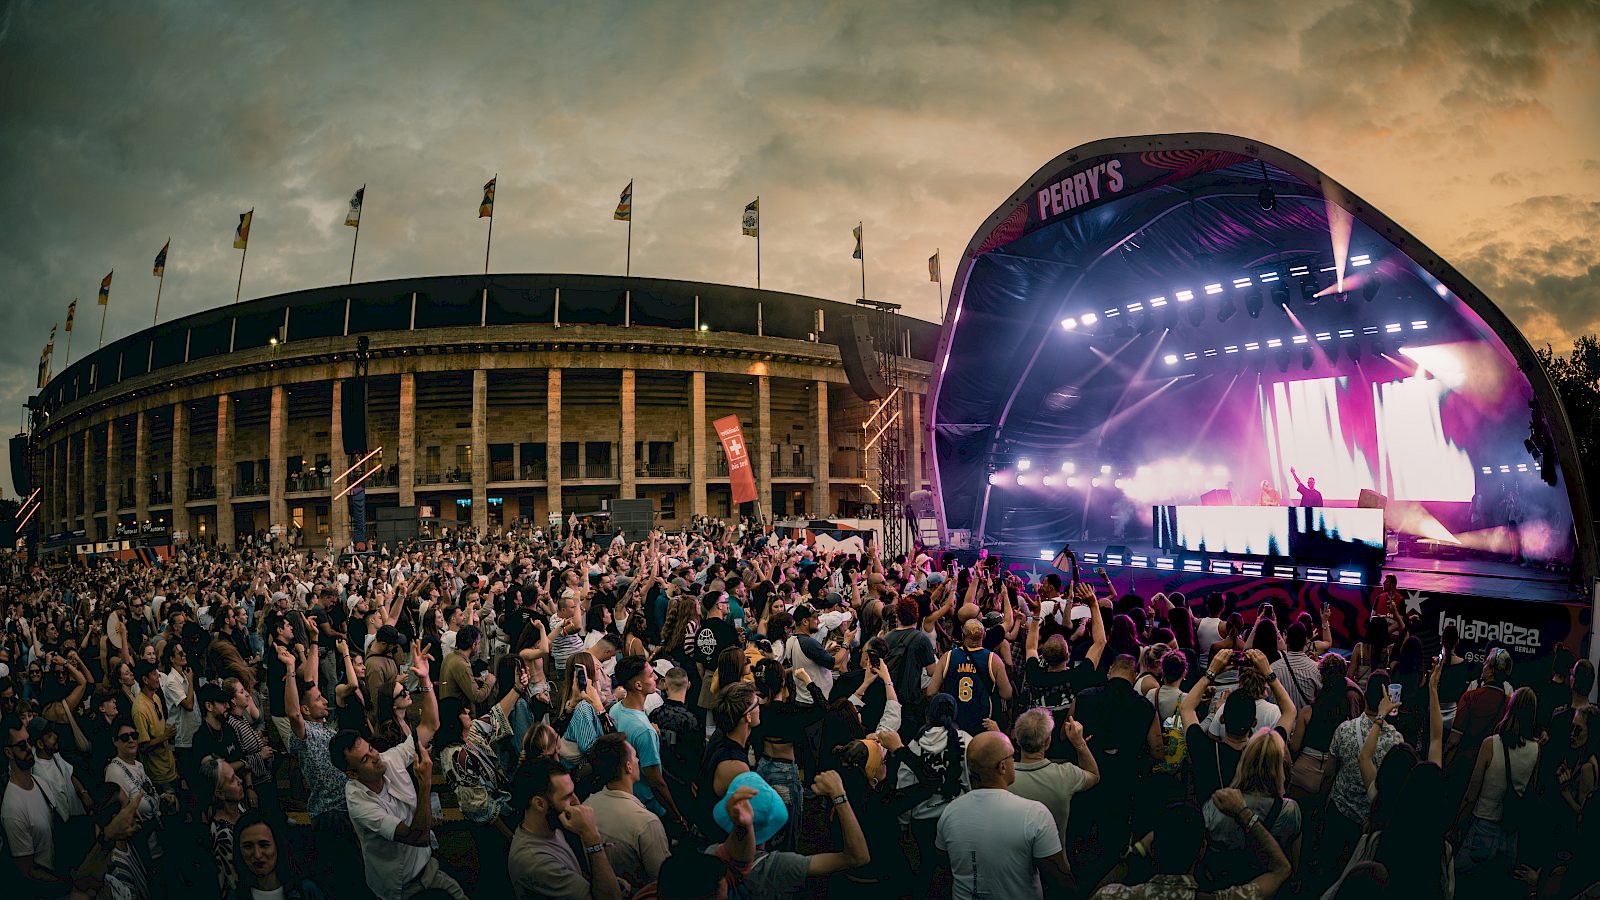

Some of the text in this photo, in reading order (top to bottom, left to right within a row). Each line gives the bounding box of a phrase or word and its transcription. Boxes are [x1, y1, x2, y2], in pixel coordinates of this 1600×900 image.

[1038, 160, 1124, 220] PERRY'S
[1515, 645, 1536, 654] BERLIN
[959, 676, 974, 702] 6
